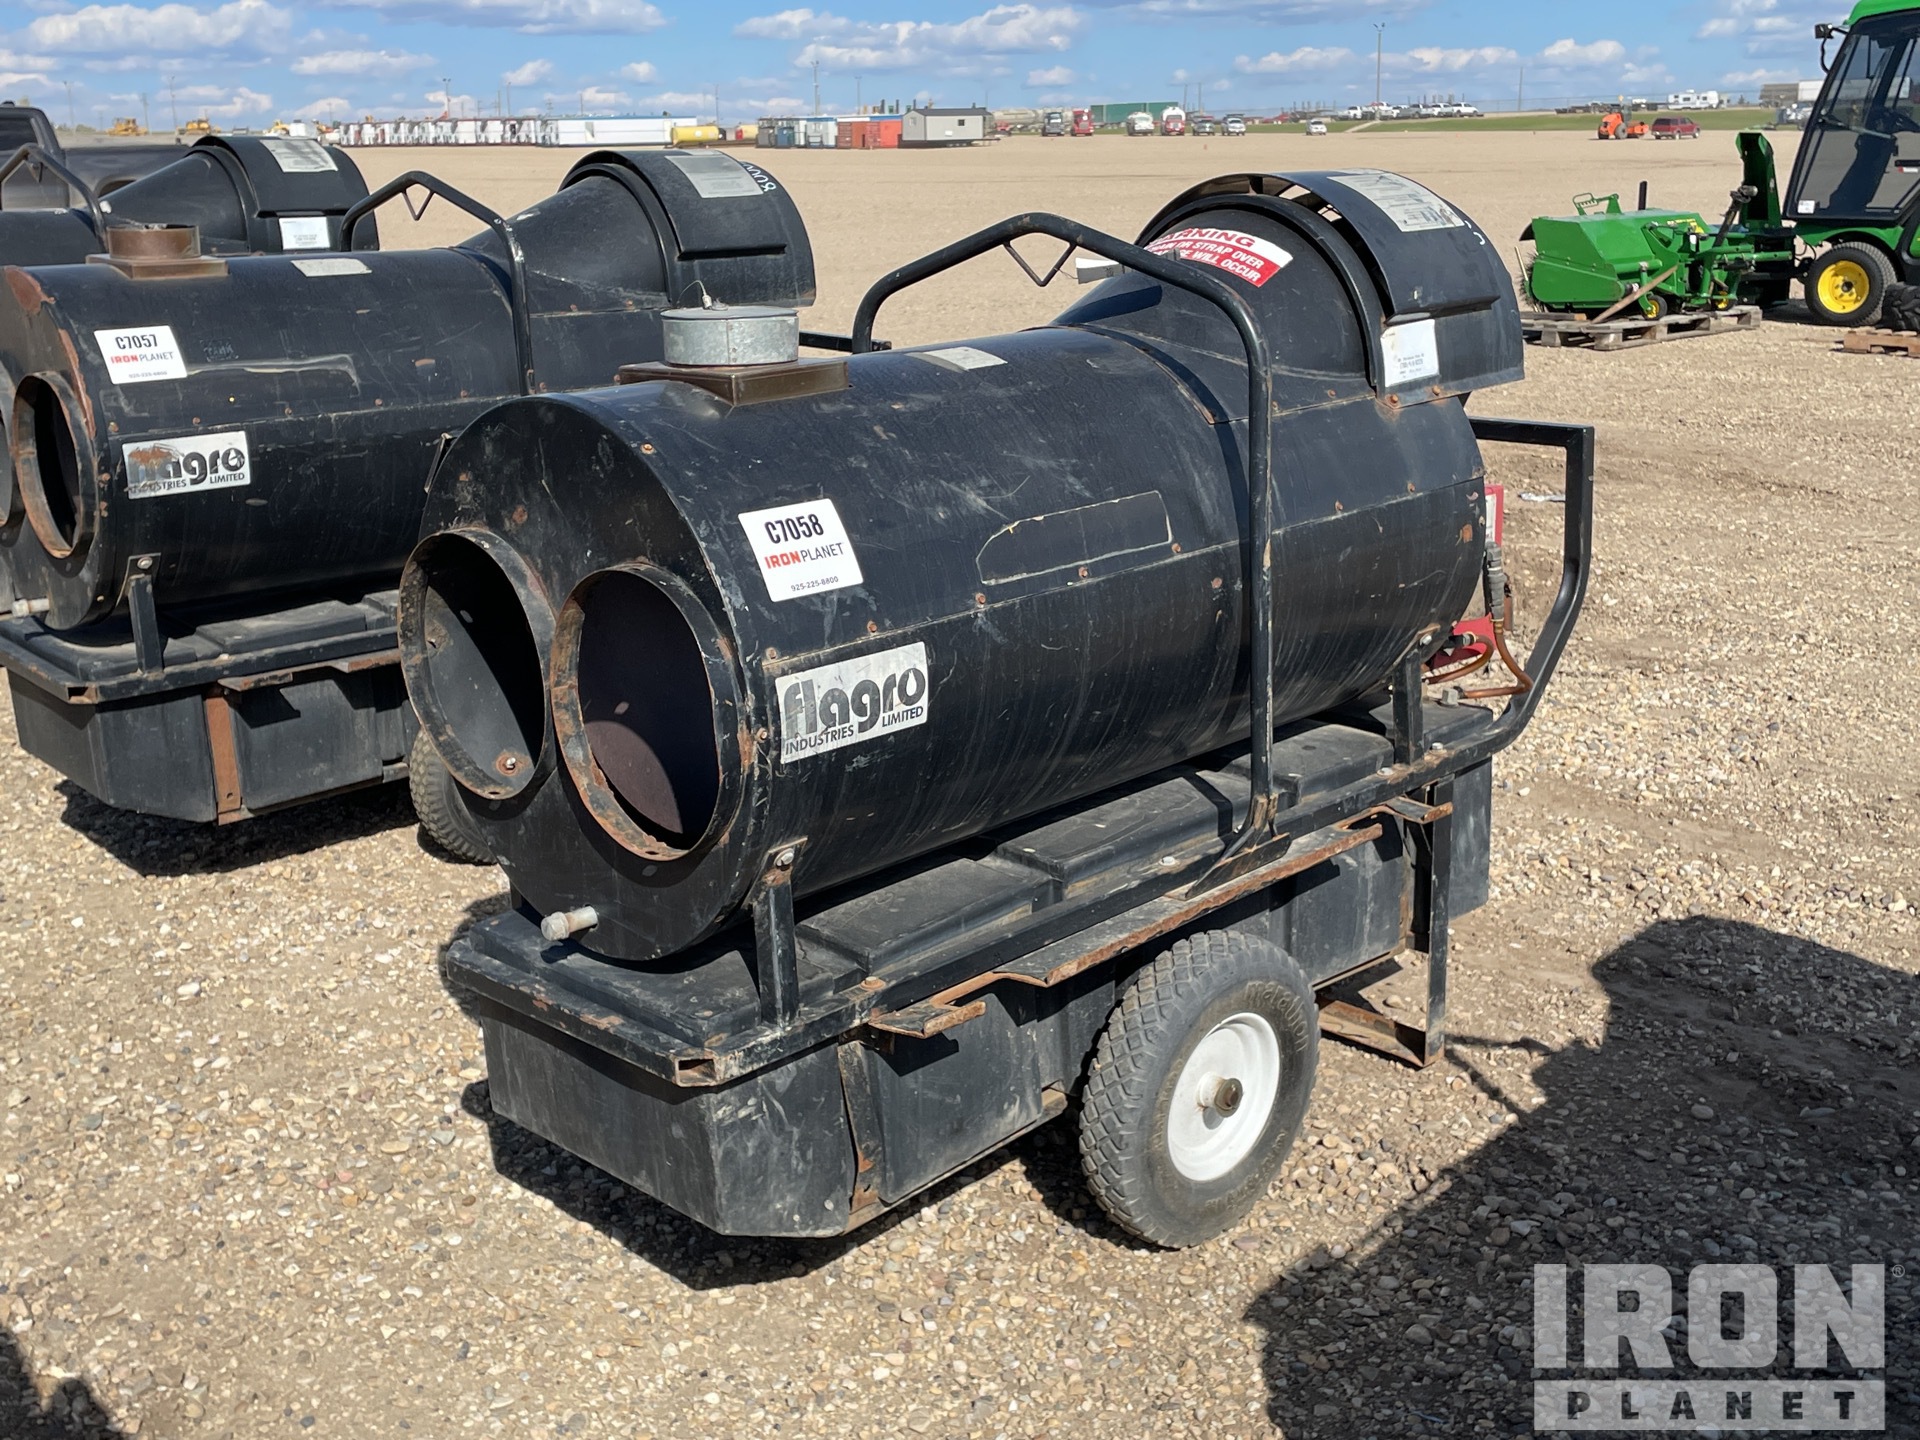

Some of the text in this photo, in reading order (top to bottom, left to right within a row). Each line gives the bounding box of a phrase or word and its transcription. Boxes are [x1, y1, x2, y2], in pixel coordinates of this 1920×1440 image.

[1192, 241, 1233, 254] STRAP
[1231, 250, 1265, 269] OVER
[1192, 251, 1220, 264] WILL
[1220, 258, 1262, 282] OCCUR
[115, 334, 158, 350] C7057
[210, 472, 245, 484] LIMITED
[764, 513, 824, 544] C7058
[790, 575, 839, 592] 925-225-8800
[783, 667, 926, 740] flagro
[785, 706, 924, 756] INDUSTRIES LIMITED
